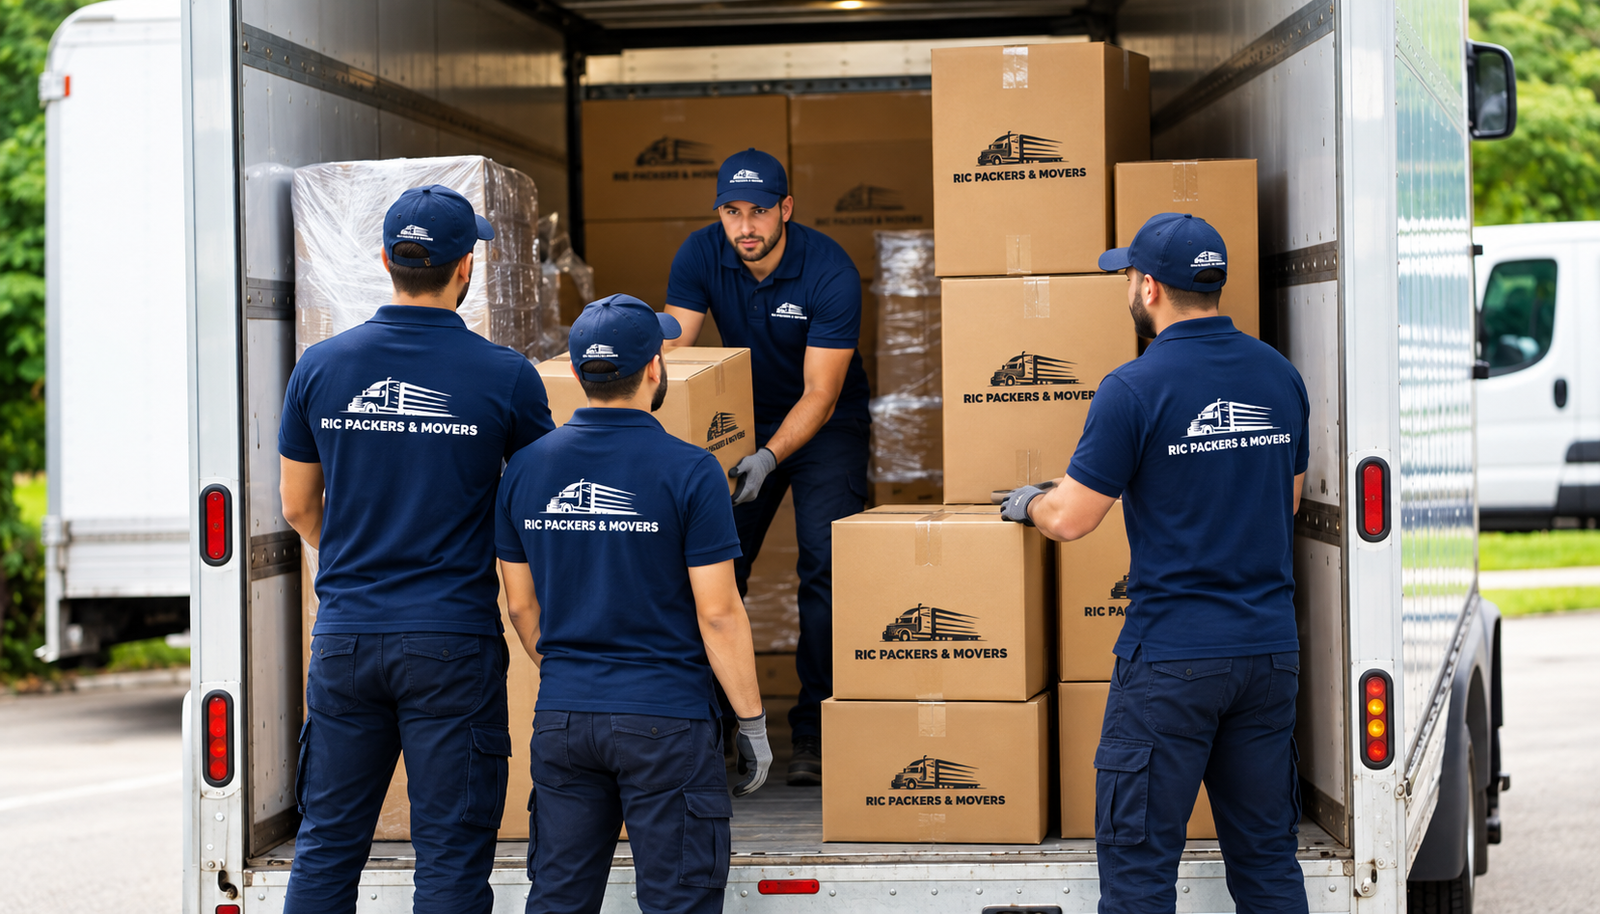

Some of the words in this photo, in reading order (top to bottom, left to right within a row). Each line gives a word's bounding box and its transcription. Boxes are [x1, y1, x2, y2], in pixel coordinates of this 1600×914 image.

[954, 173, 972, 183] RIC
[975, 171, 1025, 182] PACKERS
[1028, 170, 1036, 179] &
[1039, 168, 1086, 178] MOVERS
[964, 394, 983, 403] RIC
[986, 392, 1039, 402] PACKERS
[1042, 392, 1050, 401] &
[1054, 391, 1095, 401] MOVER
[321, 418, 342, 429] RIC
[345, 419, 405, 432] PACKERS
[408, 422, 417, 432] &
[421, 423, 477, 435] MOVERS
[1168, 444, 1187, 455] RIC
[1190, 438, 1238, 453] PACKERS
[1240, 438, 1248, 447] &
[1250, 434, 1290, 446] MOVERS
[525, 520, 542, 529] RIC
[545, 520, 596, 530] PACKERS
[599, 521, 606, 531] &
[609, 521, 658, 532] MOVERS
[1085, 607, 1105, 616] RIC
[855, 650, 876, 659] RIC
[880, 649, 938, 659] PACKERS
[941, 649, 950, 659] &
[954, 648, 1007, 658] MOVERS
[866, 797, 885, 805] RIC
[889, 796, 941, 805] PACKERS
[945, 796, 952, 805] &
[956, 796, 1005, 805] MOVERS
